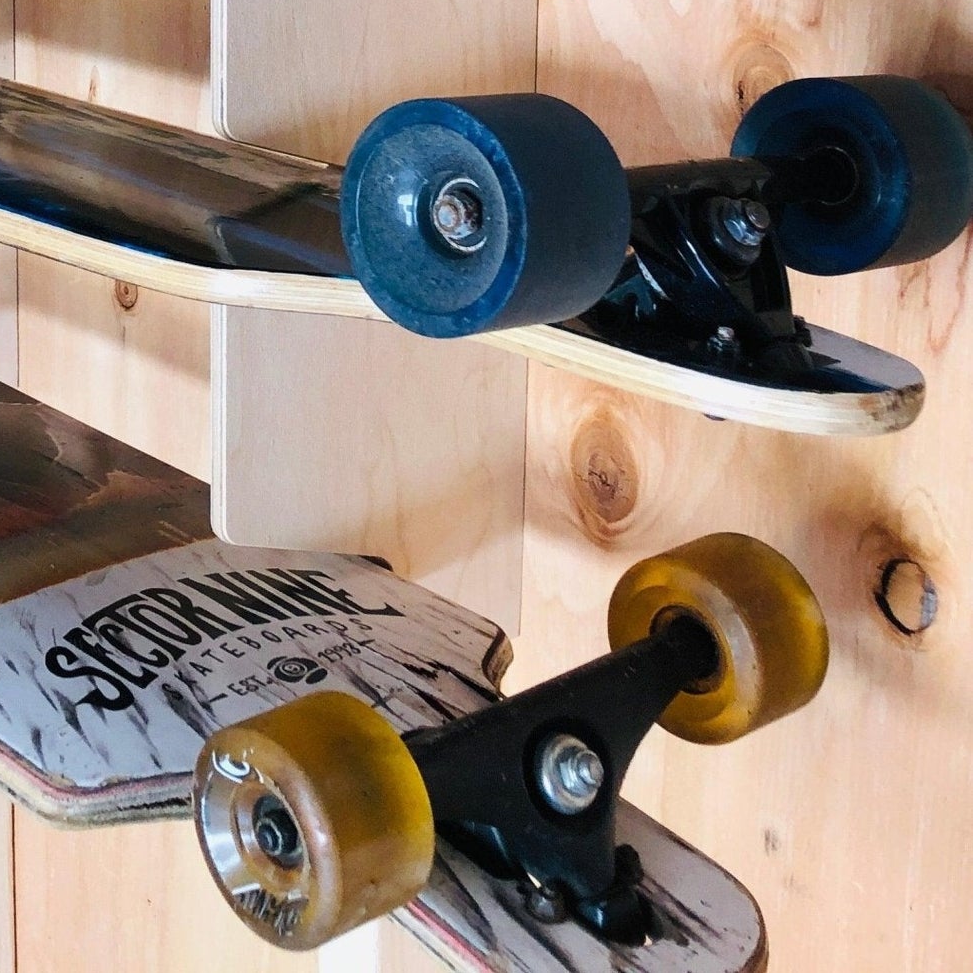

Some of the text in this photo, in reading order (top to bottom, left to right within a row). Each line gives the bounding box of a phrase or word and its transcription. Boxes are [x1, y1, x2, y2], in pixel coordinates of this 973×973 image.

[45, 568, 406, 710] SECTOR NINE
[161, 618, 373, 700] SKATEBOARDS
